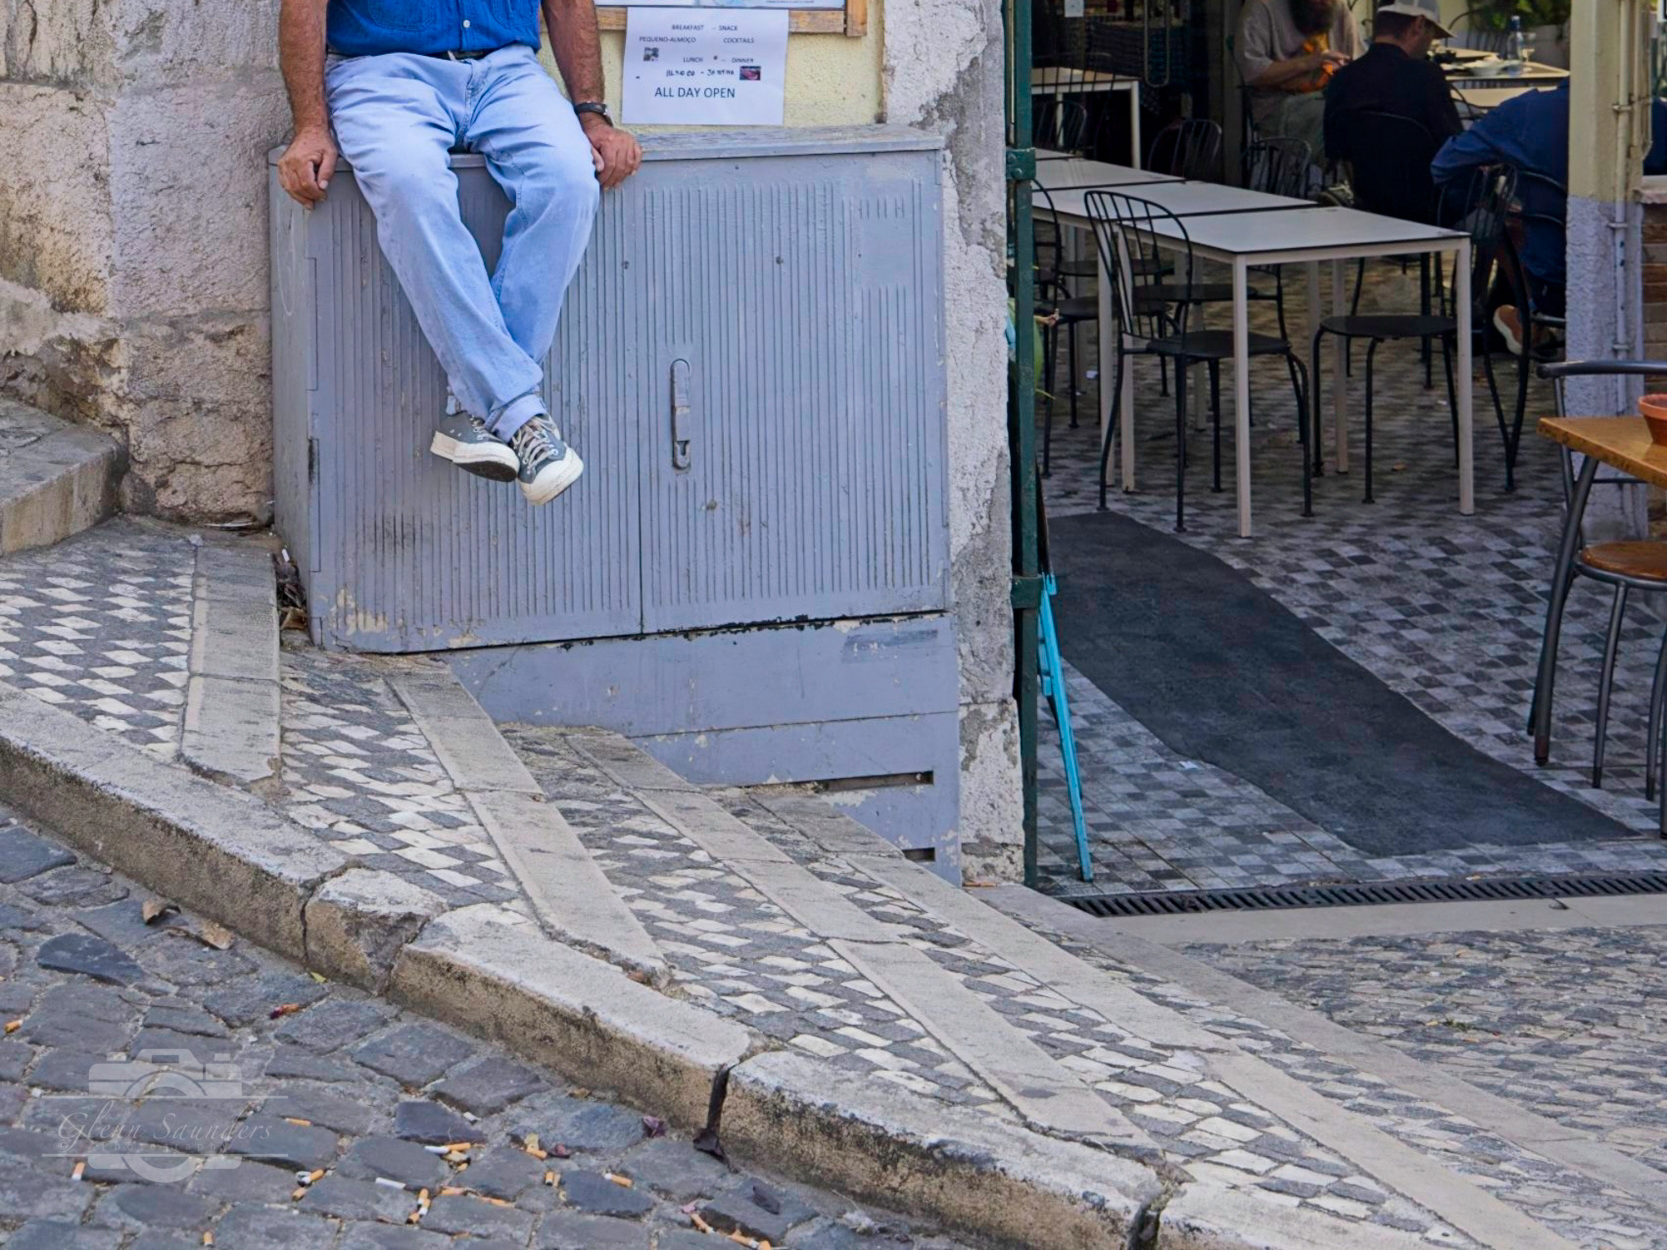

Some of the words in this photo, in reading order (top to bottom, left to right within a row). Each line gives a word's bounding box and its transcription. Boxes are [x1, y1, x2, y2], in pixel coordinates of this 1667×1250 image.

[654, 87, 675, 98] ALL
[677, 87, 701, 98] DAY
[704, 87, 736, 99] OPEN
